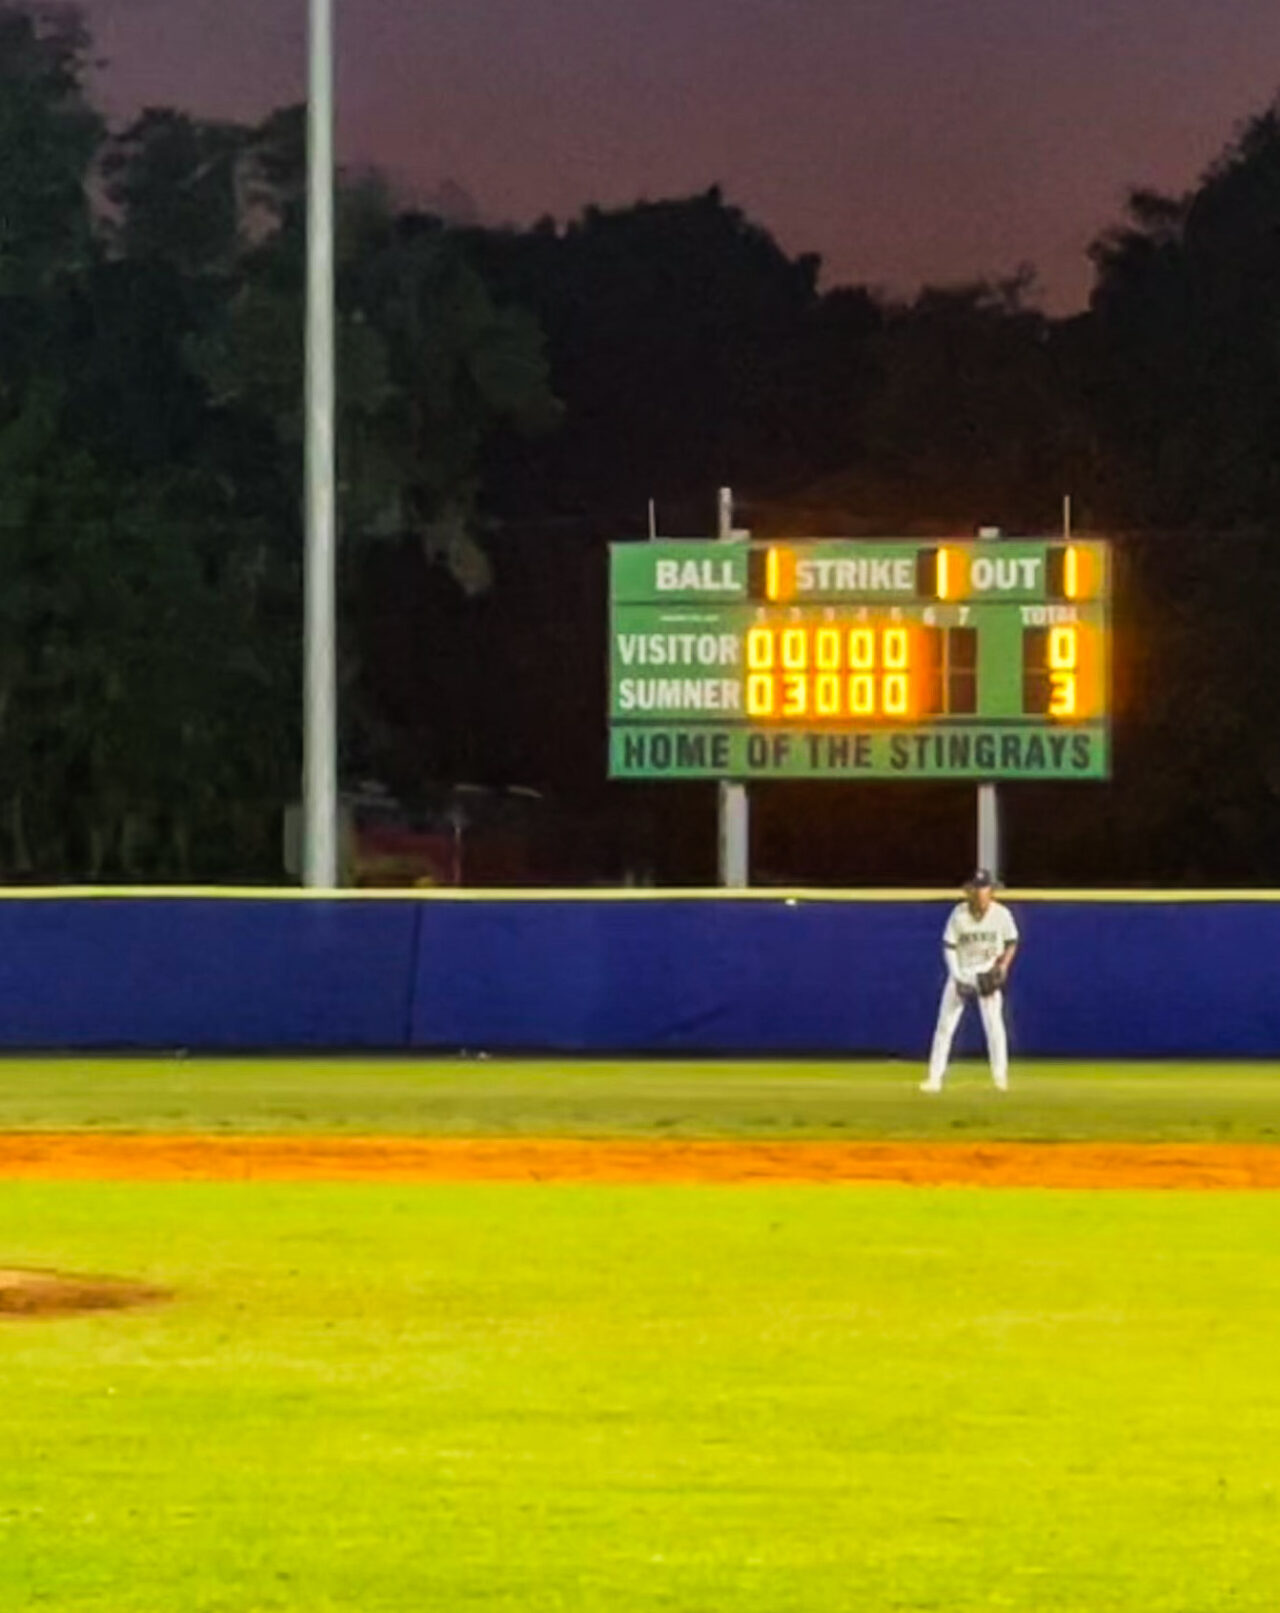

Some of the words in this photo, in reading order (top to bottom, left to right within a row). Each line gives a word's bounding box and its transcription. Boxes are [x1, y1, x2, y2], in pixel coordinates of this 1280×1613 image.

[655, 559, 741, 591] BALL
[796, 559, 913, 590] STRIKE
[971, 559, 1041, 589] OUT
[618, 634, 738, 665] VISITOR
[1049, 628, 1076, 668] 0
[619, 678, 740, 710] SUMNER
[1049, 674, 1076, 715] 3
[625, 733, 729, 769] HOME
[747, 733, 790, 768] OF
[804, 733, 872, 768] THE
[890, 732, 1091, 769] STINGRAYS
